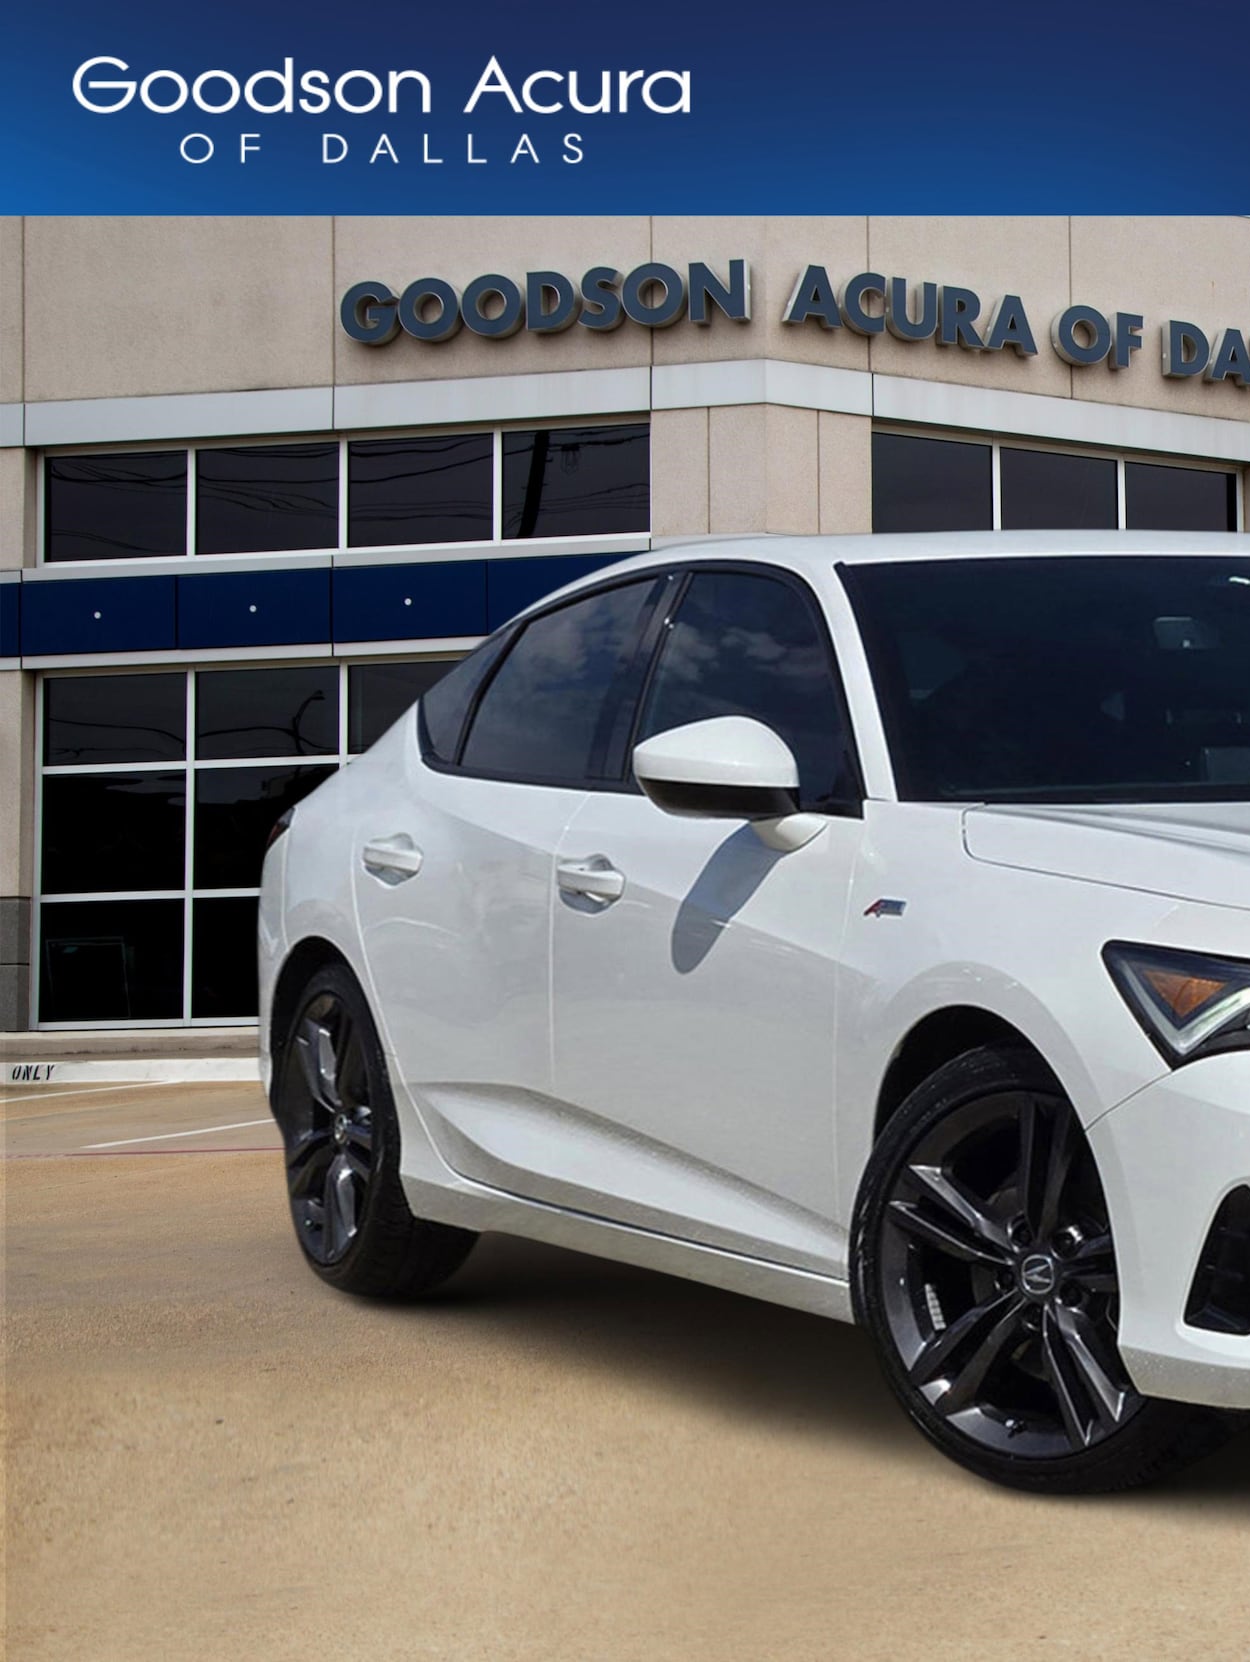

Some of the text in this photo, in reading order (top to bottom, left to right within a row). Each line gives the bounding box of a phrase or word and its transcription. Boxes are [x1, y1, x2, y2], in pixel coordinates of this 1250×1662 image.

[340, 258, 752, 346] GOODSON
[782, 264, 1038, 357] ACURA
[1051, 304, 1144, 370] OF
[11, 1064, 55, 1081] ONLY
